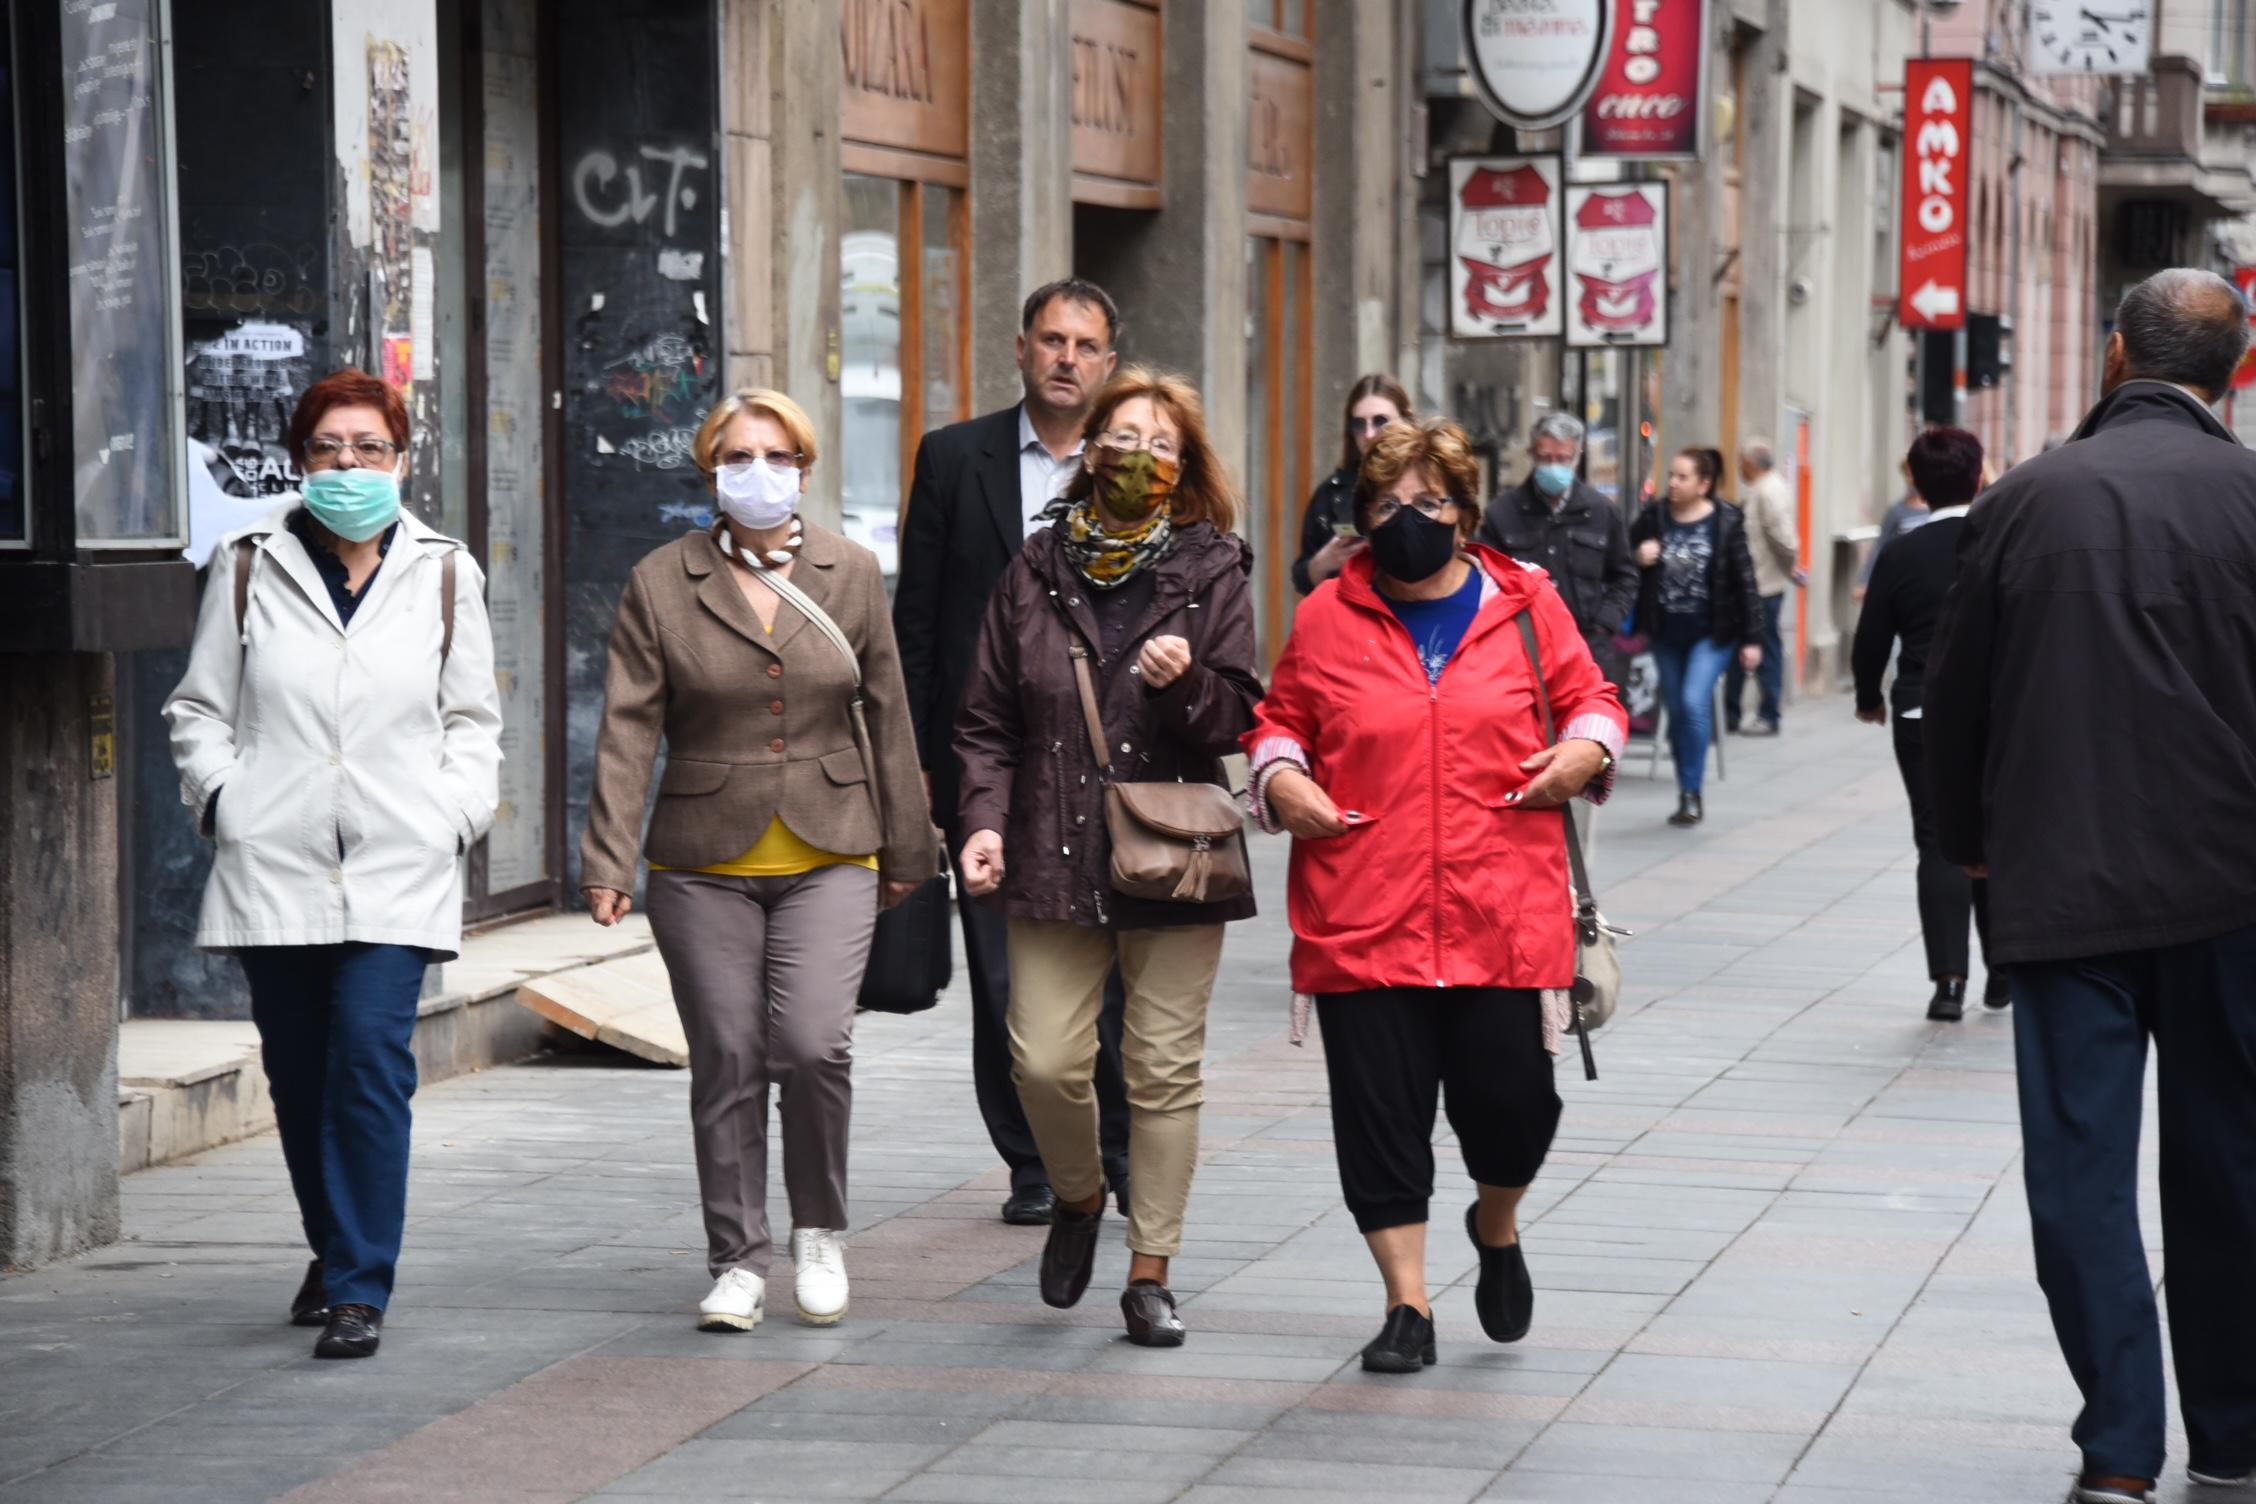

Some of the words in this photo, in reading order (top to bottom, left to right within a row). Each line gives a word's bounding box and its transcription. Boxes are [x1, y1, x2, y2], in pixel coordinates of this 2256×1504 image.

[1917, 75, 1960, 234] AMKO
[224, 339, 239, 352] IN
[244, 338, 293, 353] ACTION
